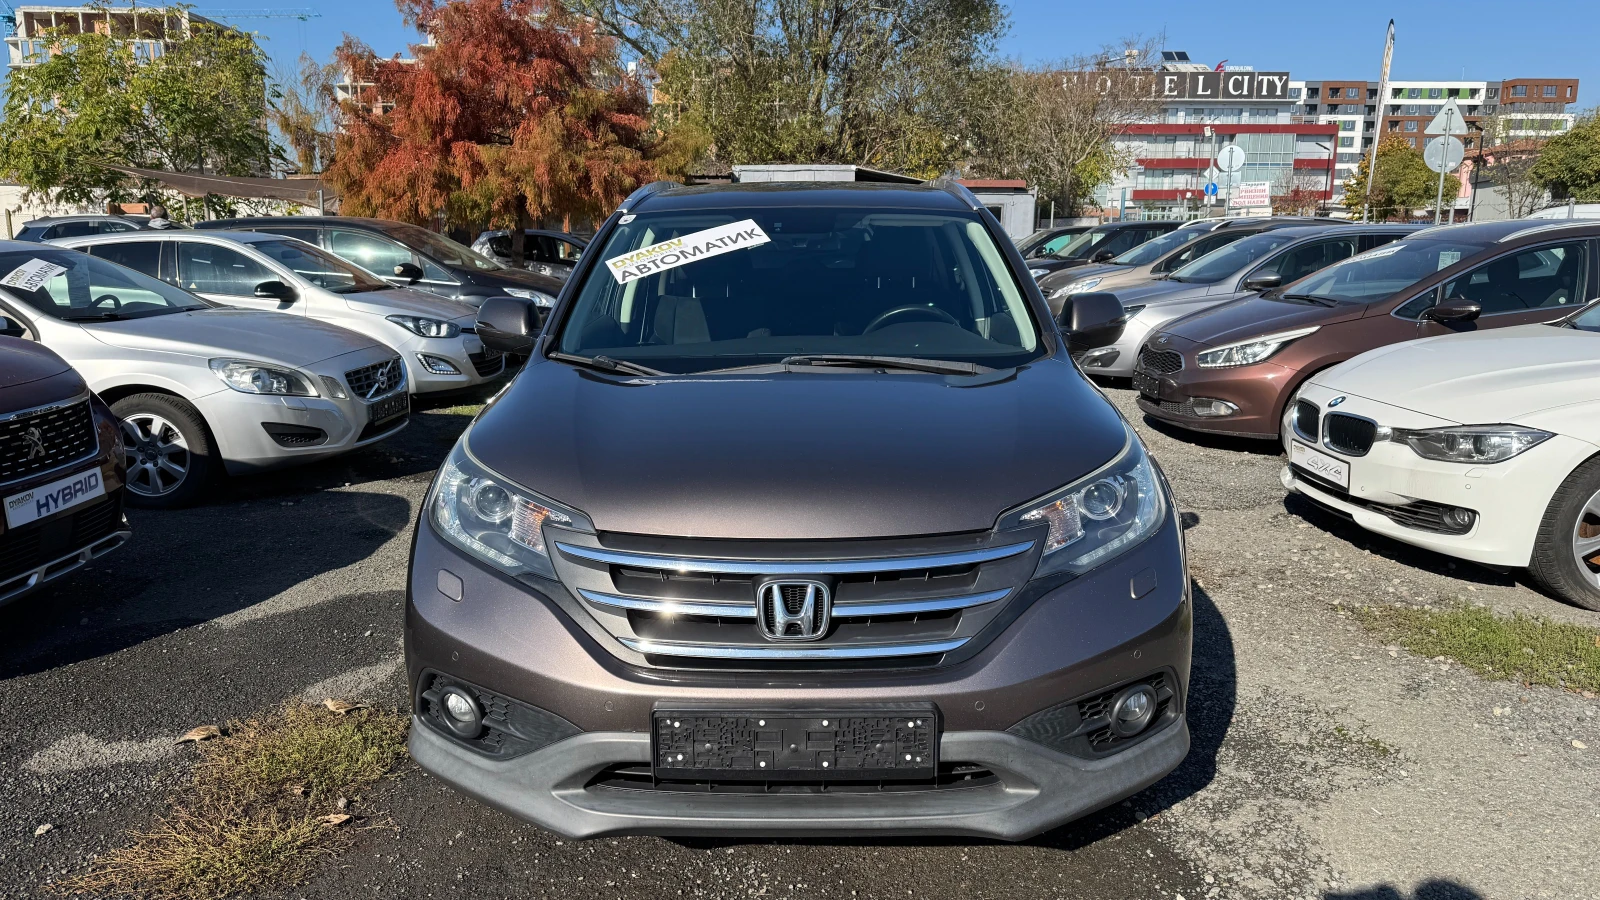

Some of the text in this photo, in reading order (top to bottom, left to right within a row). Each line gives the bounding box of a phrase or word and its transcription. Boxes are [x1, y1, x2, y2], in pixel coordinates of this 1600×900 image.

[1227, 75, 1288, 96] CITY
[612, 238, 683, 269] DYAKOV
[621, 227, 763, 283] АВТОМАТИК
[9, 491, 34, 509] DYAKOV
[36, 472, 99, 517] HYBRID
